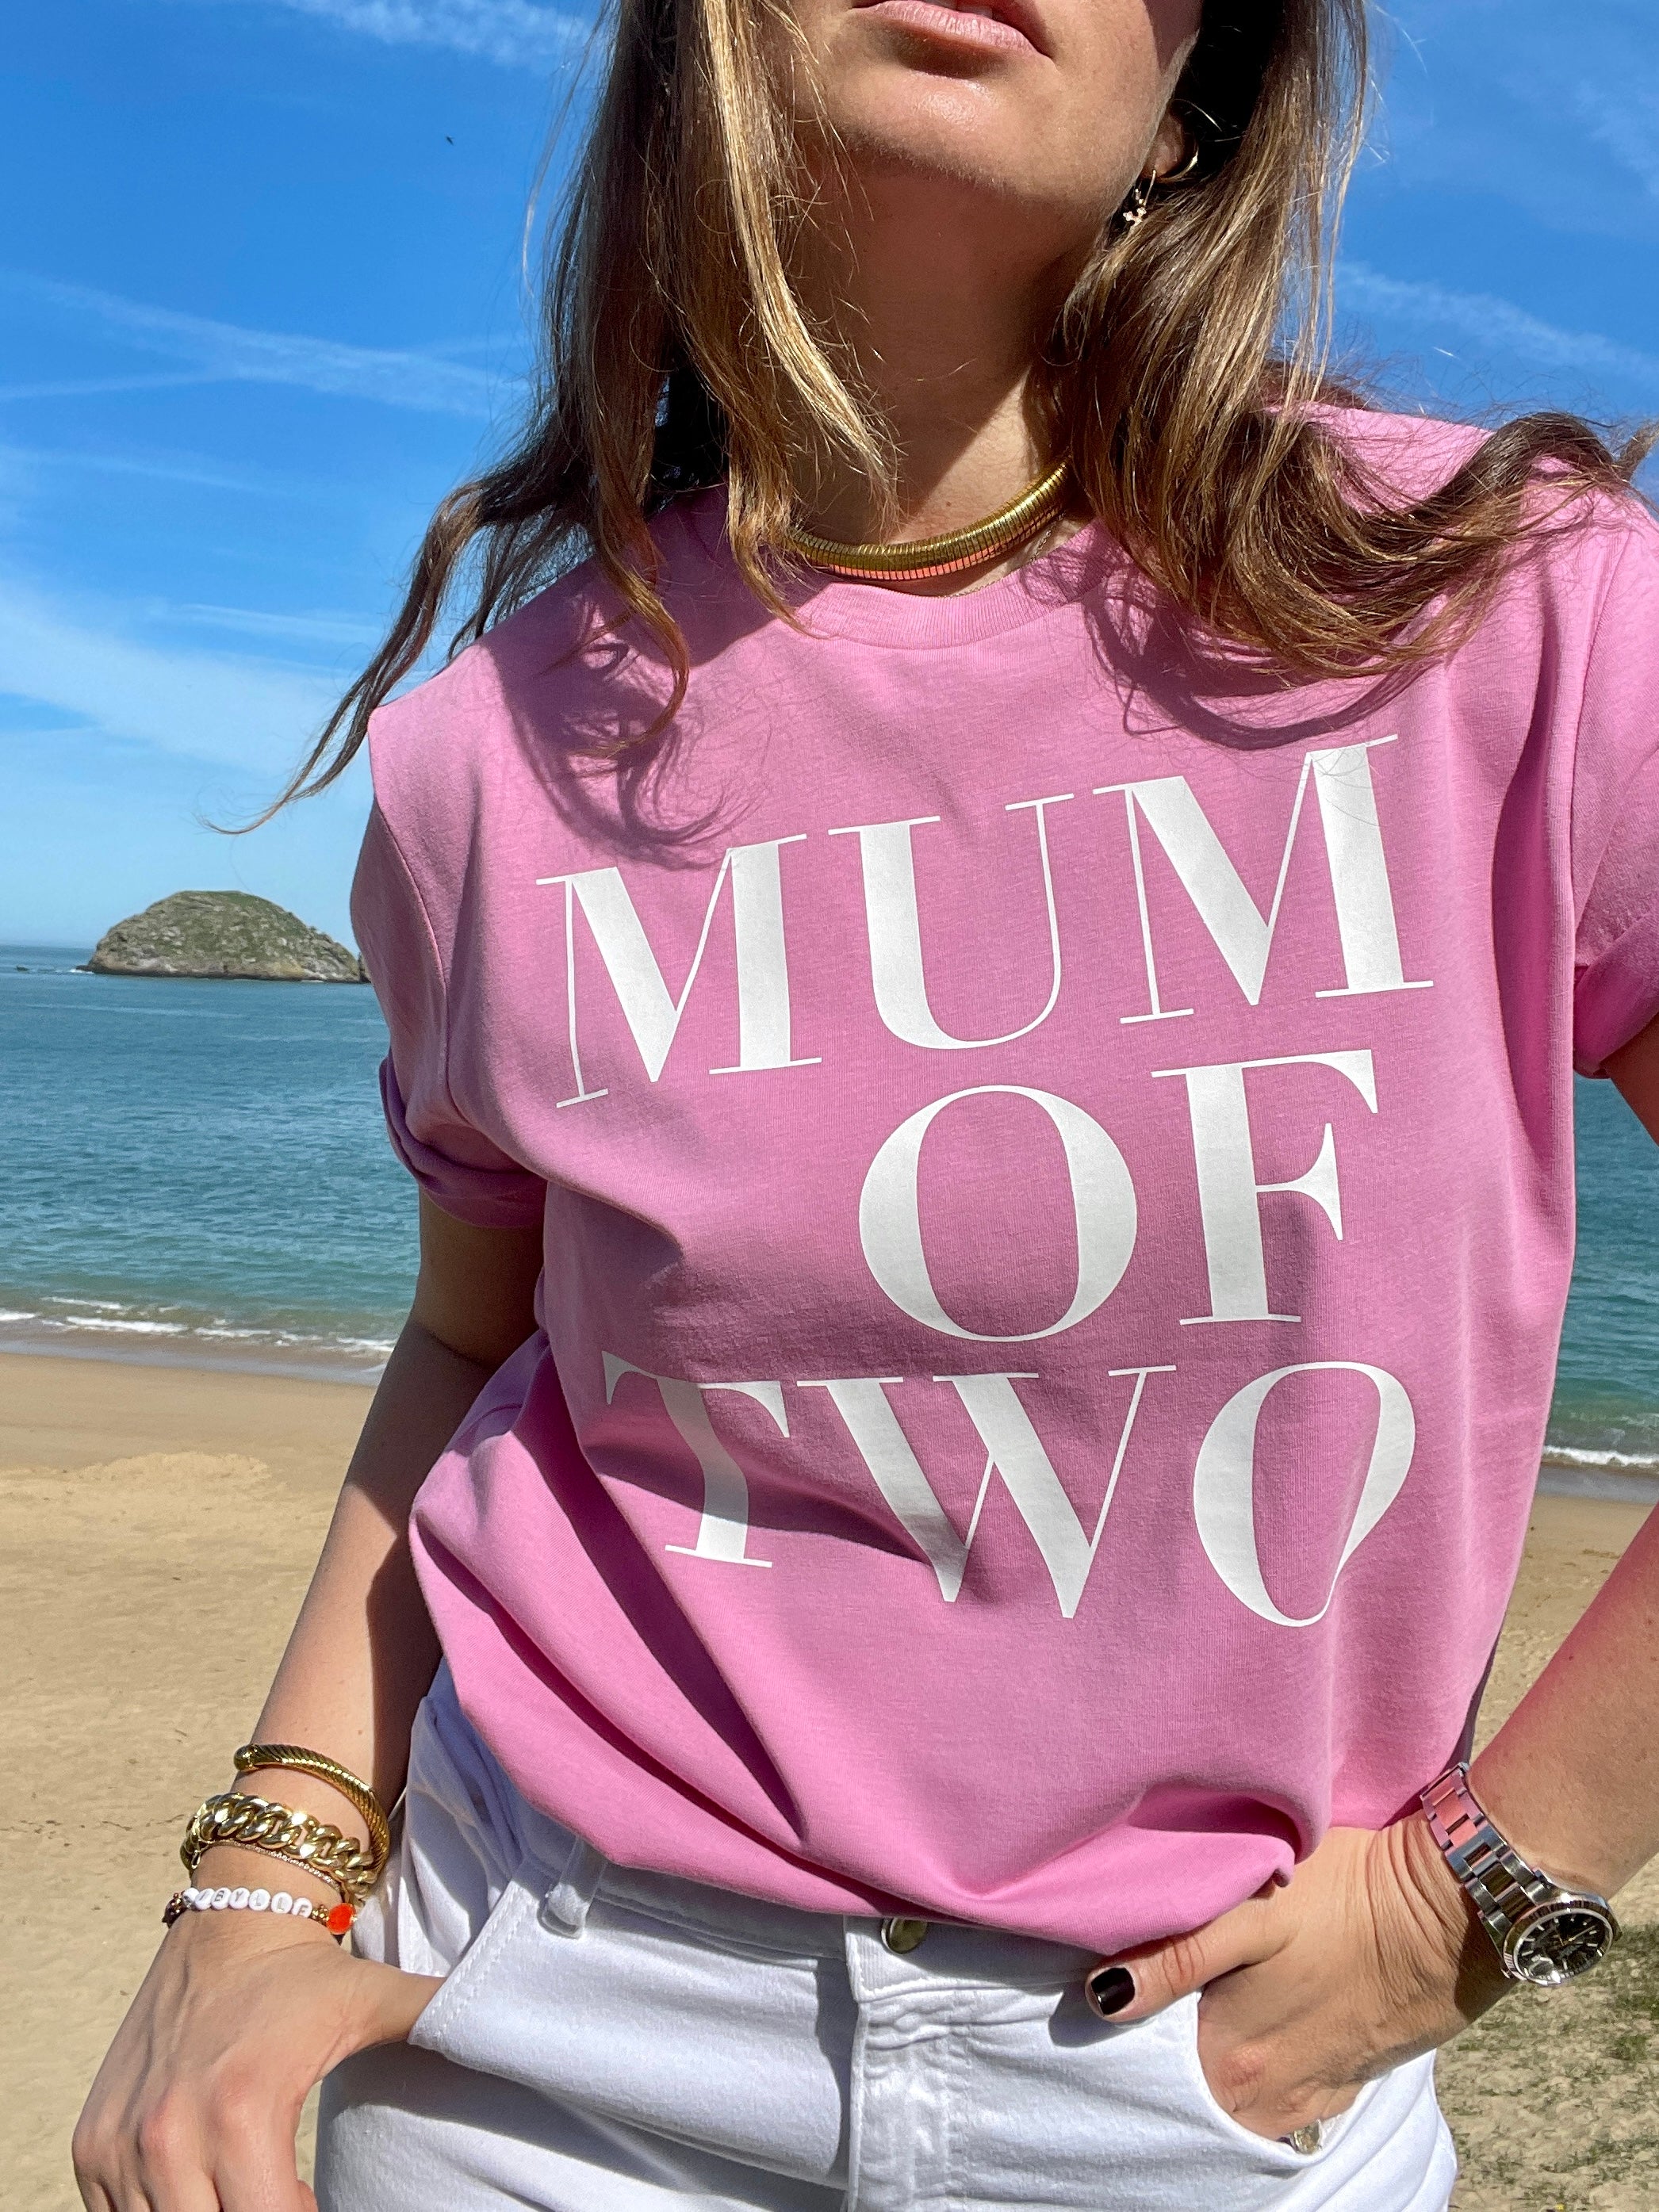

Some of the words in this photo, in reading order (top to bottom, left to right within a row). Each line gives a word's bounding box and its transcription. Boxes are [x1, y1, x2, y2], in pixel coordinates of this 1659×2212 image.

[536, 734, 1434, 1108] MUM
[858, 1049, 1378, 1342] OF
[602, 1351, 1416, 1627] TWO
